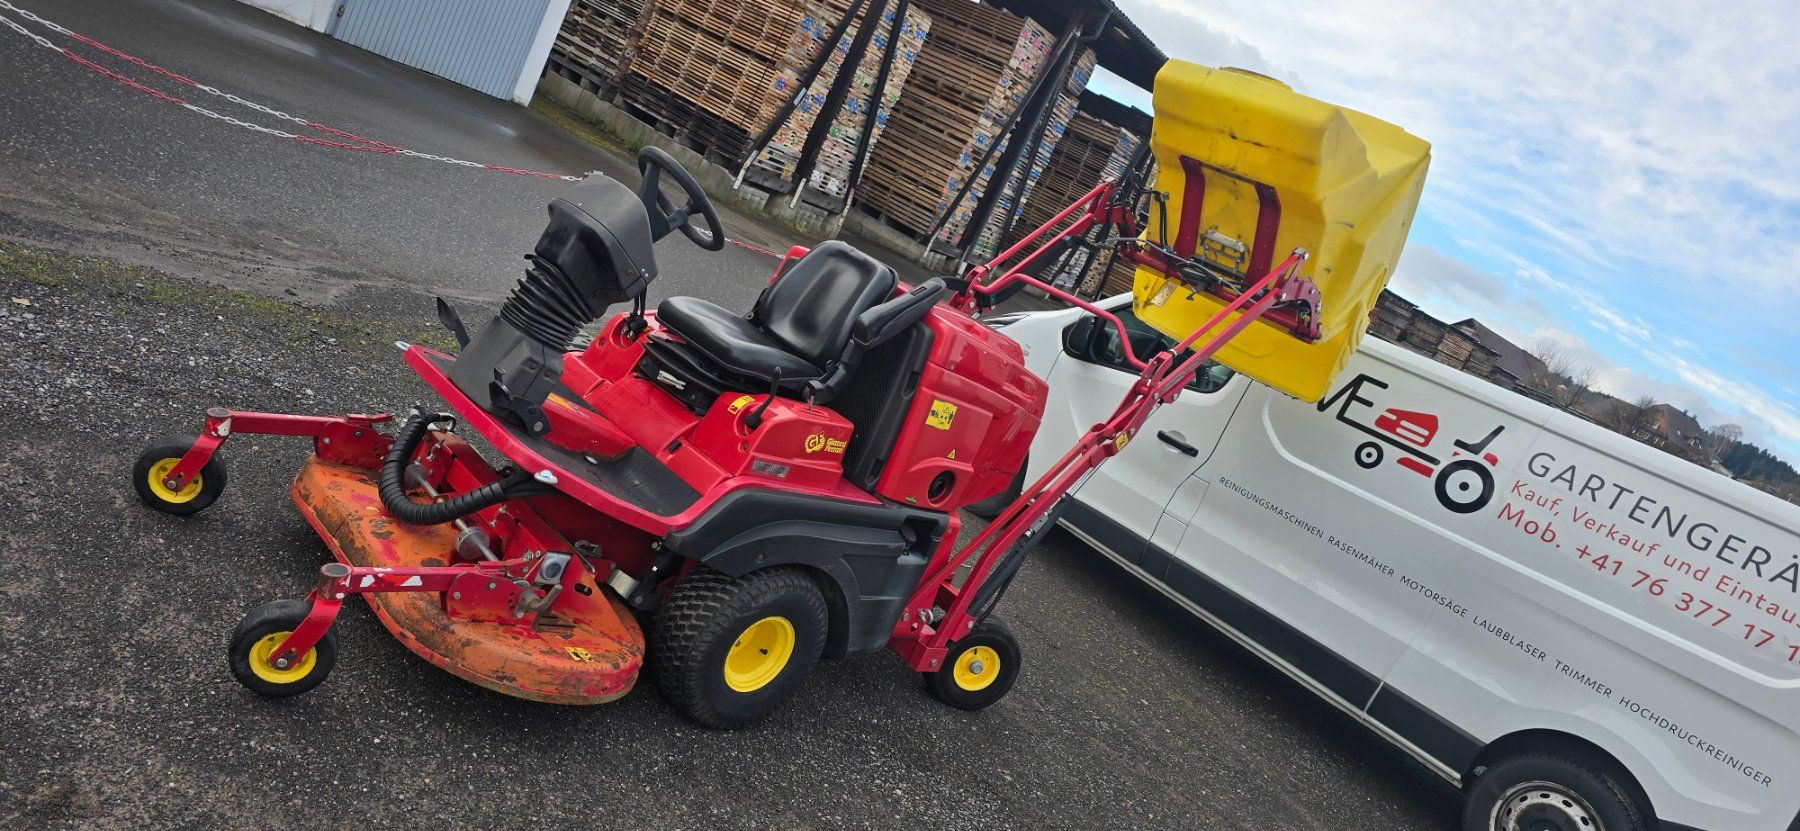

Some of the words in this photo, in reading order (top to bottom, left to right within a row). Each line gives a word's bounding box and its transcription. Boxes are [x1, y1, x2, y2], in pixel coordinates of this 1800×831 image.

[1497, 502, 1561, 548] Mob.
[1576, 545, 1623, 576] +41
[1631, 569, 1669, 596] 76
[1674, 592, 1732, 627] 377
[1743, 624, 1776, 648] 17
[1511, 480, 1562, 516] Kauf,
[1572, 507, 1661, 557] Verkauf
[1663, 555, 1710, 582] und
[1219, 476, 1324, 538] REINIGUNGSMASCHINEN
[1327, 536, 1395, 577] RASENMÄHER
[1400, 575, 1468, 618] MOTORSÄGE
[1472, 616, 1546, 662] LAUBBLASER
[1555, 660, 1613, 699] TRIMMER
[1619, 696, 1772, 788] HOCHDRUCKREINIGER
